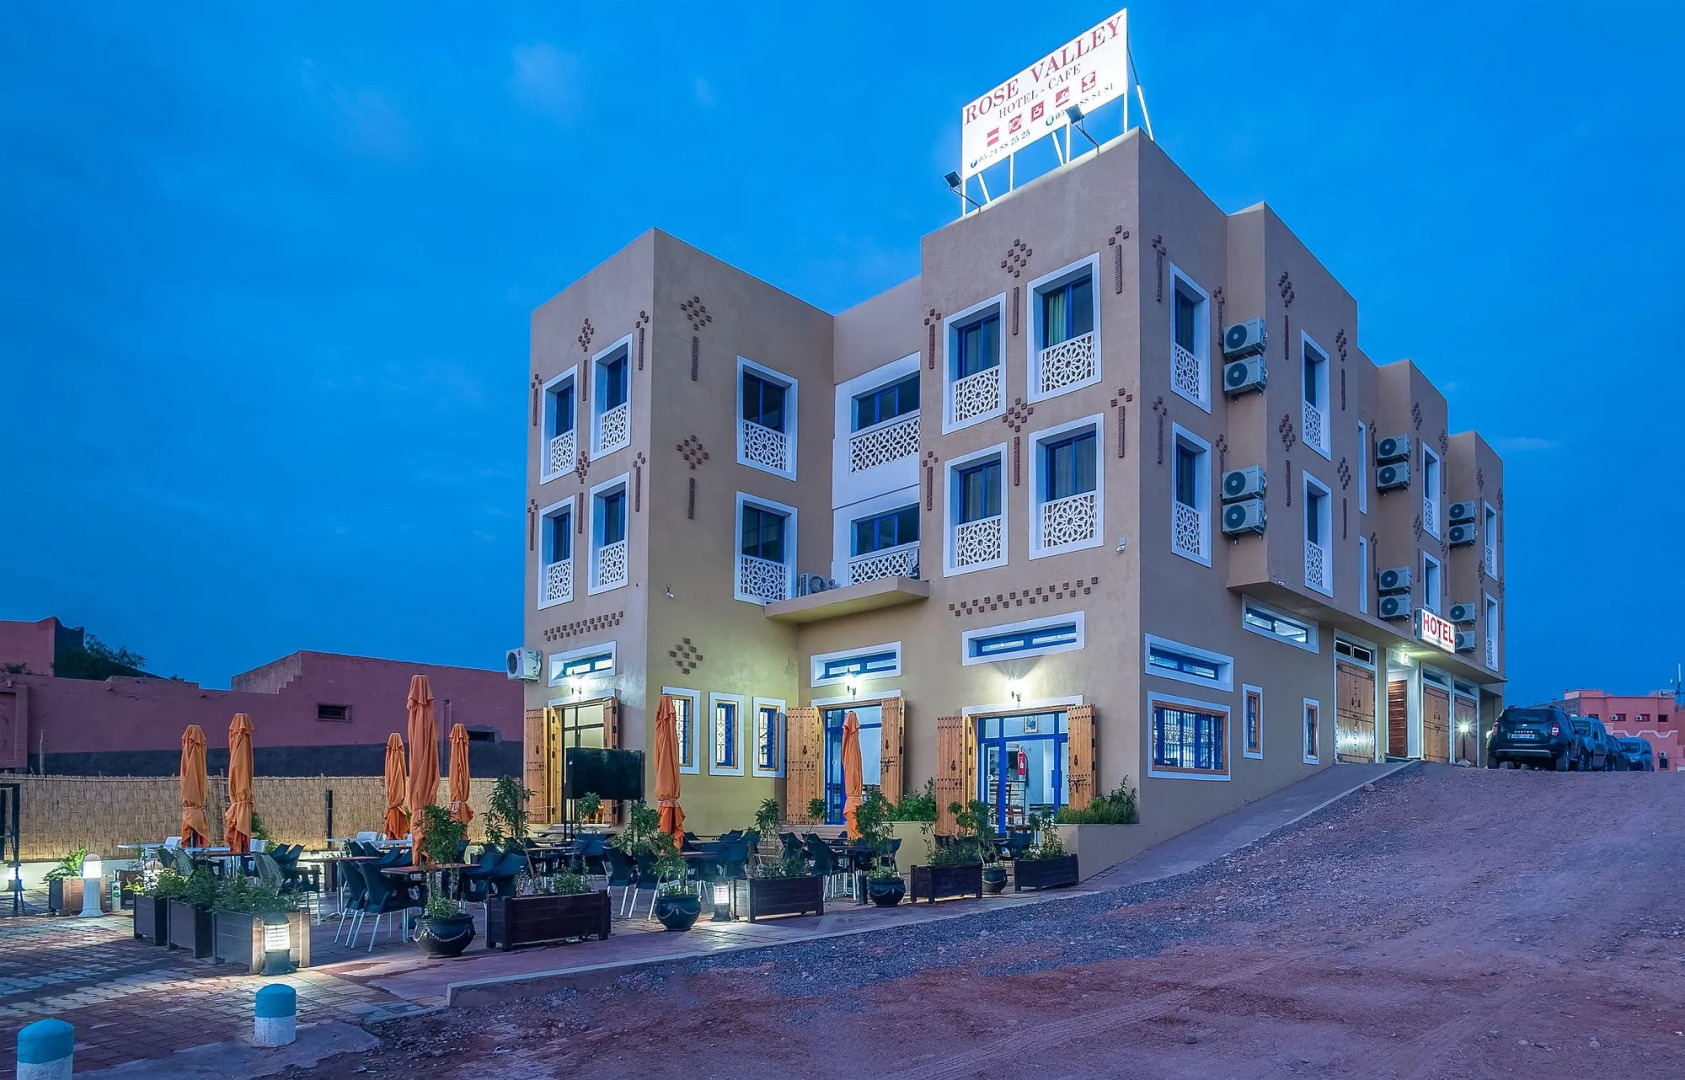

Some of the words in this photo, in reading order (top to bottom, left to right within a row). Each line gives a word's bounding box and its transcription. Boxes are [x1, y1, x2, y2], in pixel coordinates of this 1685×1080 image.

[965, 78, 1019, 126] ROSE
[1030, 15, 1123, 83] VALLEY
[999, 89, 1039, 119] HOTEL
[1048, 63, 1081, 89] CAFE
[1423, 612, 1453, 644] HOTEL
